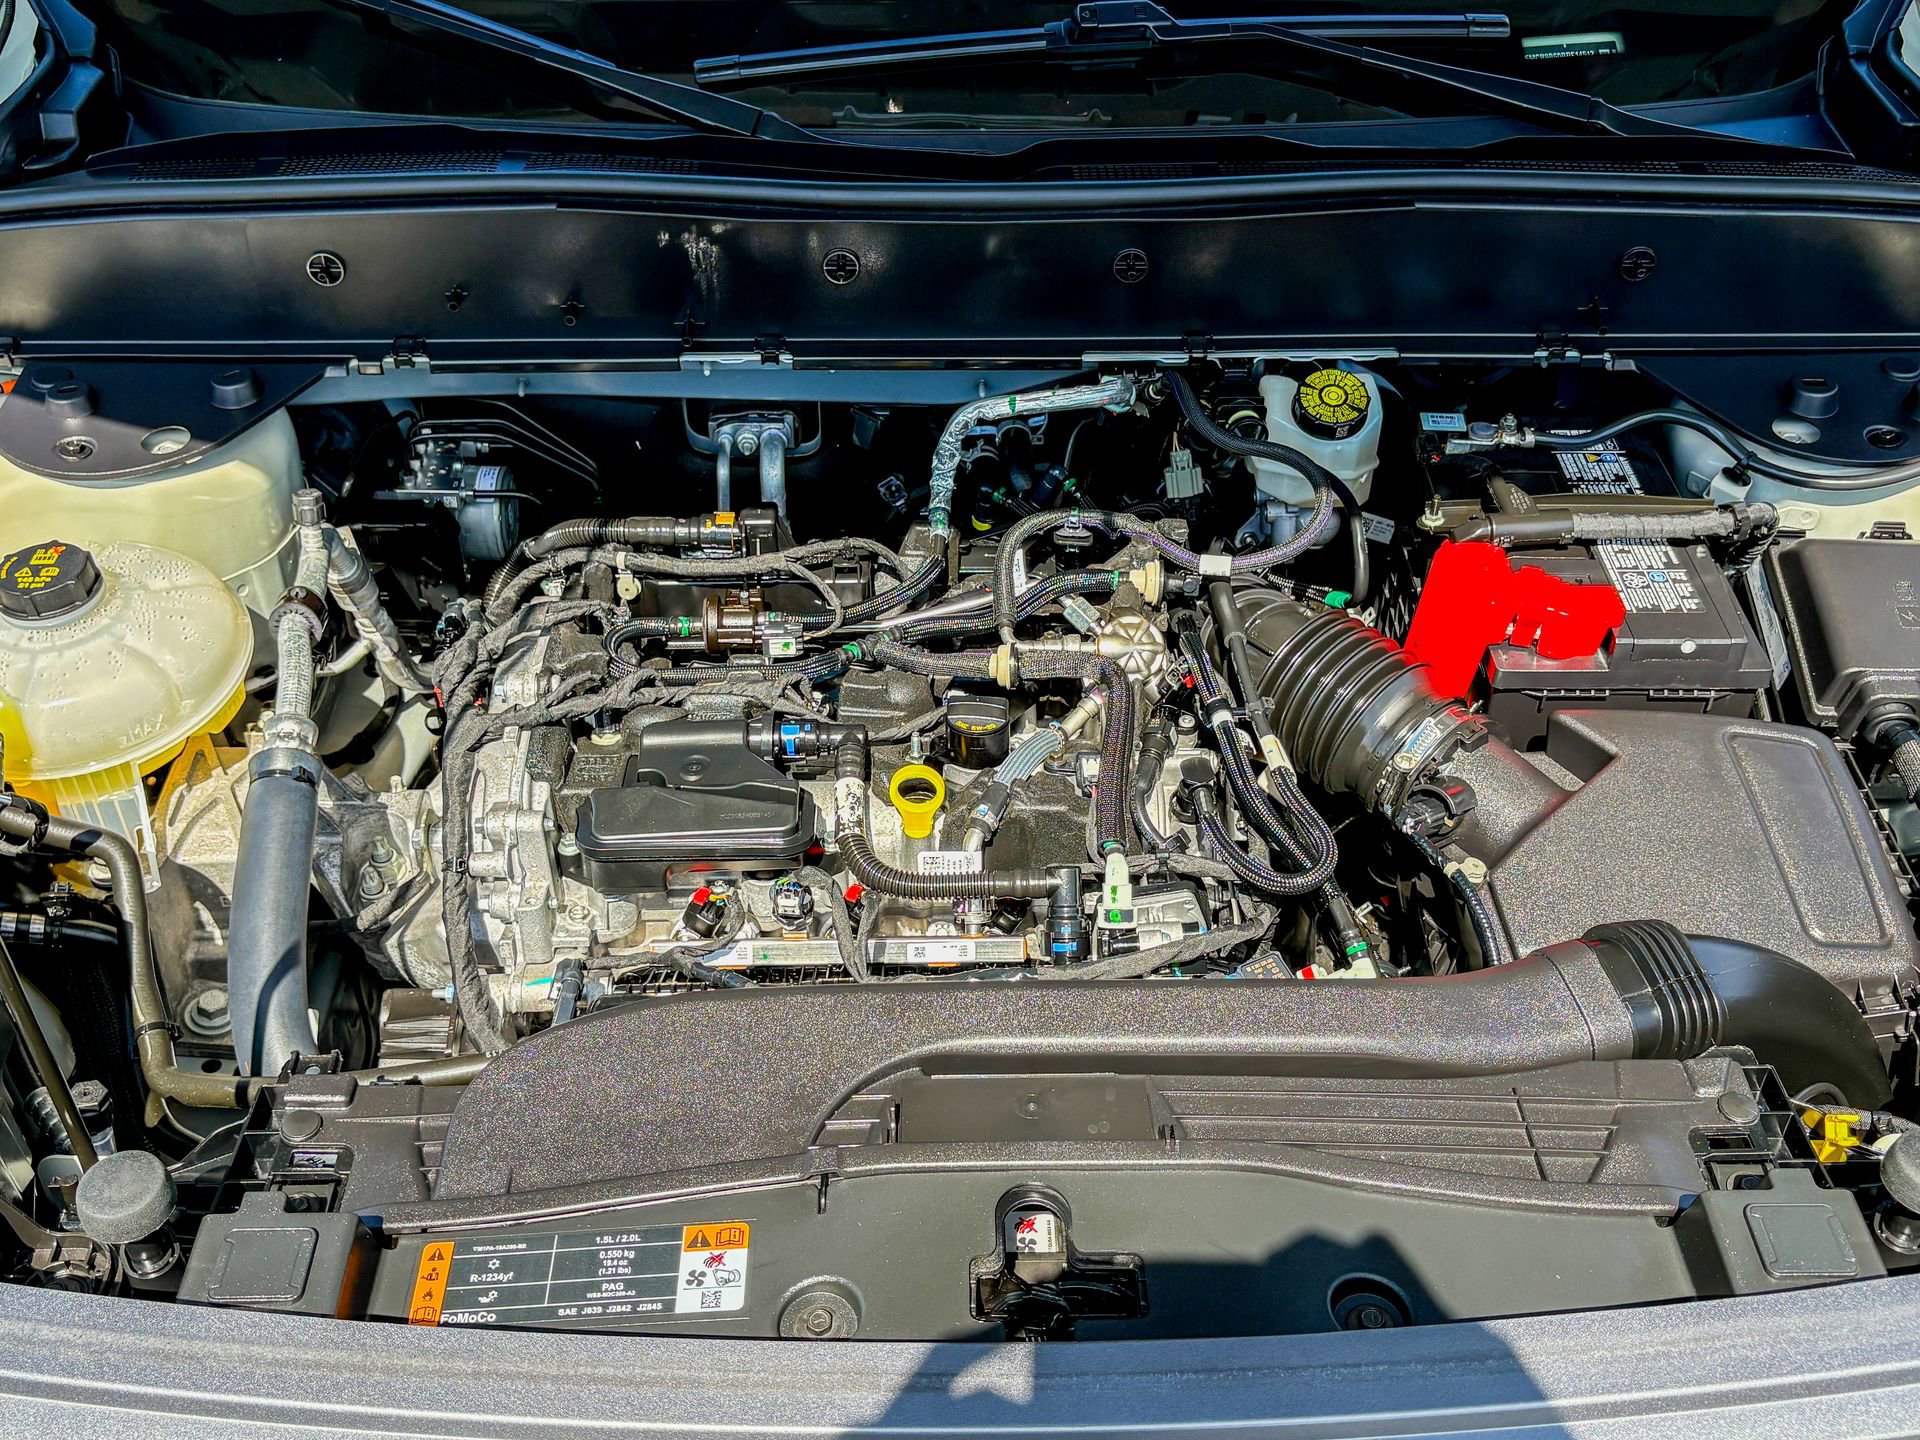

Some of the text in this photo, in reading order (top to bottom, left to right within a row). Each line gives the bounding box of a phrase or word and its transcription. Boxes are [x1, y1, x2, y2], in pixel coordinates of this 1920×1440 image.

[595, 1235, 615, 1244] 1.5L
[621, 1234, 641, 1243] 2.0L
[600, 1249, 635, 1259] 0.550 kg
[469, 1271, 514, 1283] R-1234yf
[601, 1282, 624, 1291] PAG
[558, 1307, 578, 1316] SAE
[606, 1304, 633, 1313] J2842
[636, 1302, 663, 1311] J2845
[440, 1311, 497, 1324] FoMoCo
